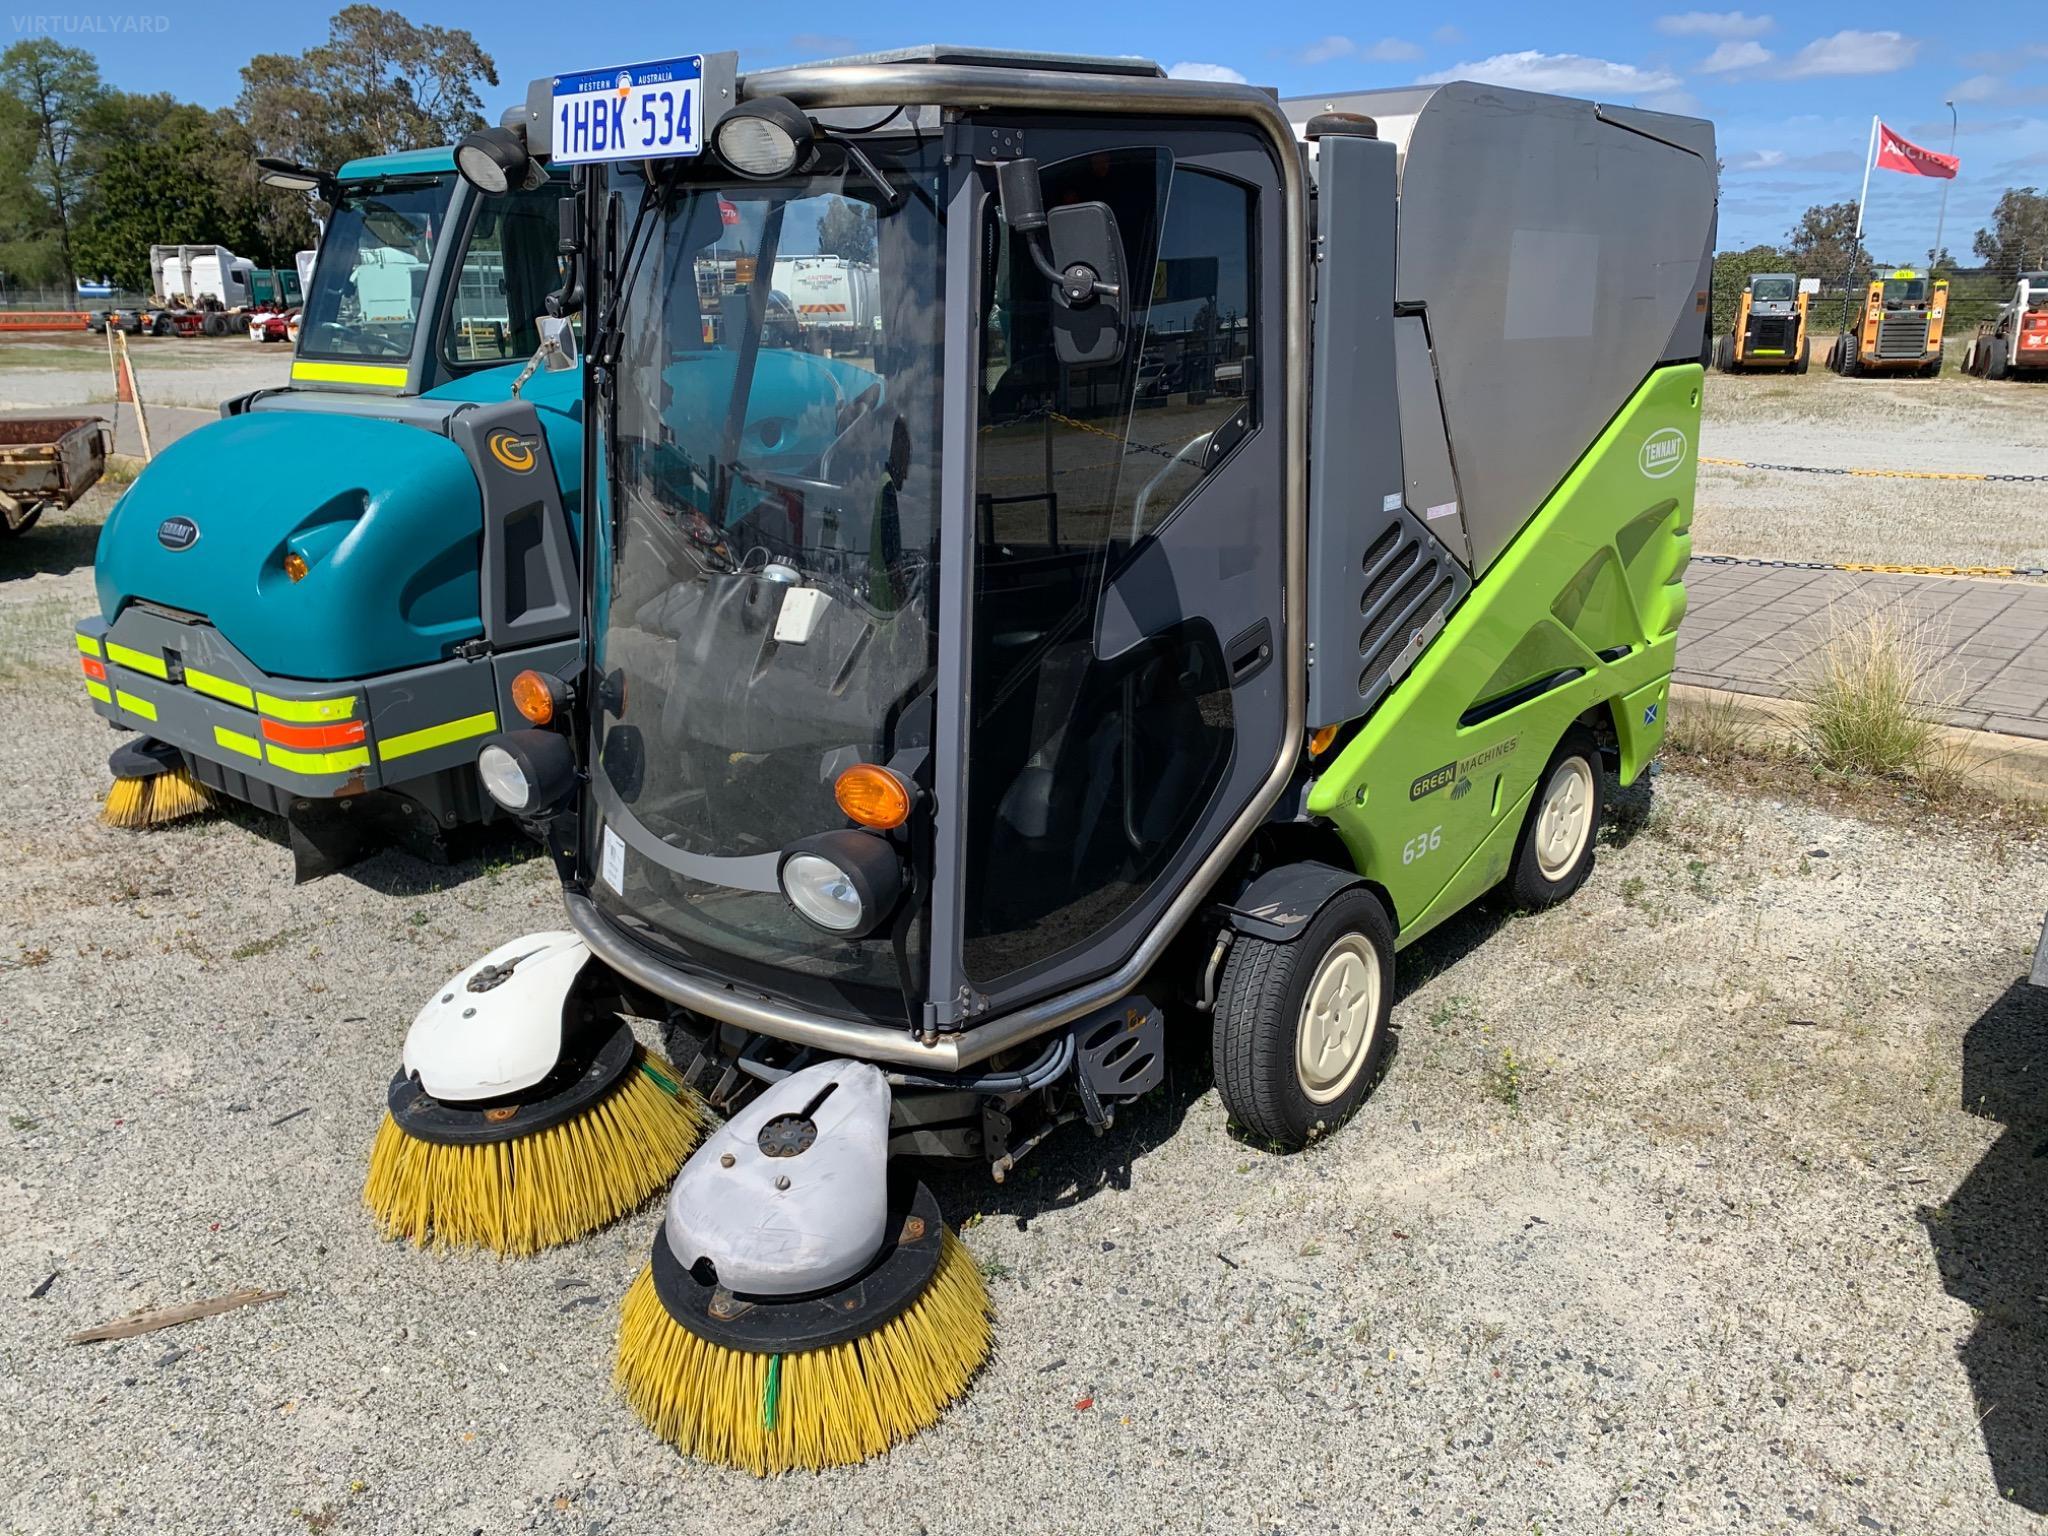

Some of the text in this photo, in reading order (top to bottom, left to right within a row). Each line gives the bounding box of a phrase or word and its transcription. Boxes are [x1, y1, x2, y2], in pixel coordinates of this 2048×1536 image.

[578, 72, 672, 92] WESTERN AUSTRALIA
[561, 89, 691, 153] 1HBK 534
[1645, 437, 1682, 468] TENNANT
[1412, 737, 1517, 797] GREEN MACHINES
[1402, 825, 1442, 865] 636
